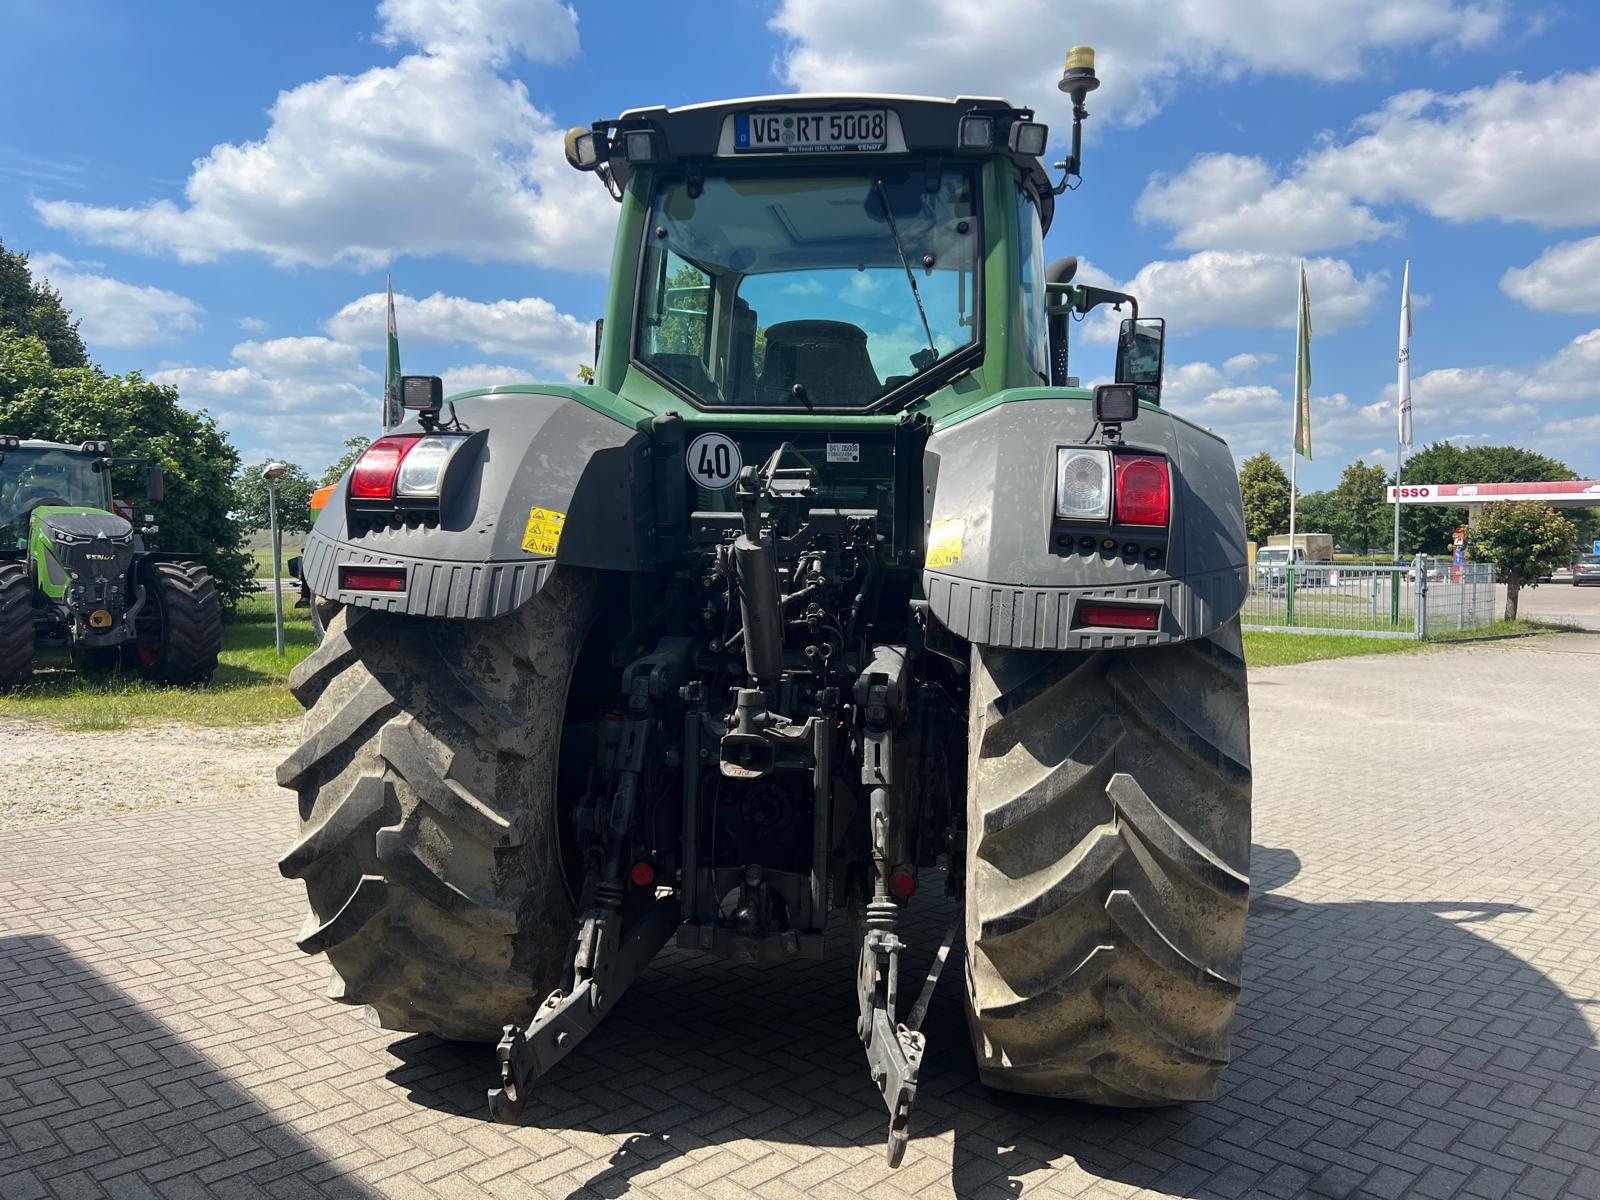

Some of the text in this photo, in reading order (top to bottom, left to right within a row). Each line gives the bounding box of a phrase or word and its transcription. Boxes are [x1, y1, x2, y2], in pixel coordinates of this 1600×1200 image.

[753, 118, 780, 143] VG
[797, 116, 824, 142] RT
[830, 114, 884, 141] 5008
[858, 143, 882, 151] FENDT
[697, 443, 731, 479] 40
